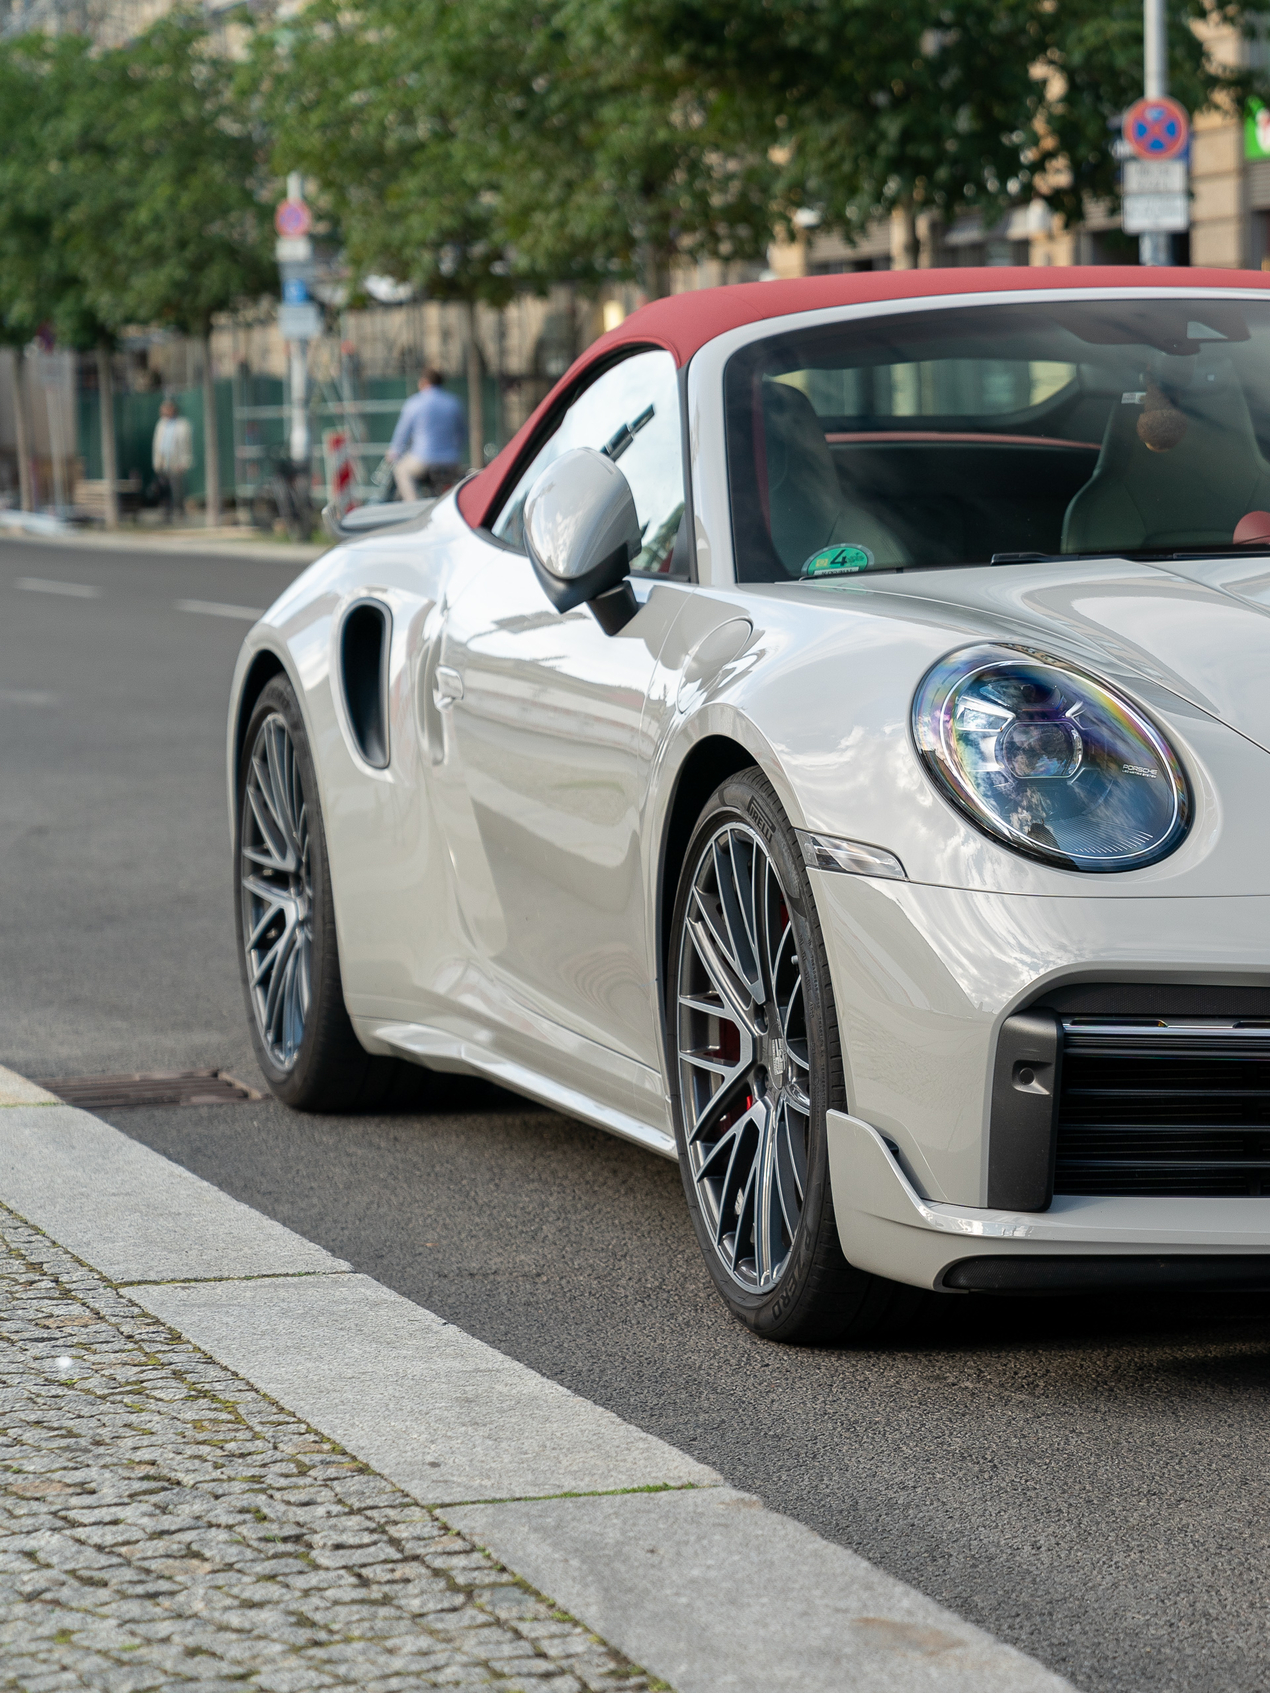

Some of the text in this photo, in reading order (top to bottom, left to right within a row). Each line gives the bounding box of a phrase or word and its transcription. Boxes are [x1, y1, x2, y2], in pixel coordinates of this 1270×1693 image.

[830, 549, 847, 566] 4
[1122, 763, 1158, 775] PORSCHE
[746, 795, 776, 844] PIRELLI
[771, 1249, 807, 1321] ZERO
